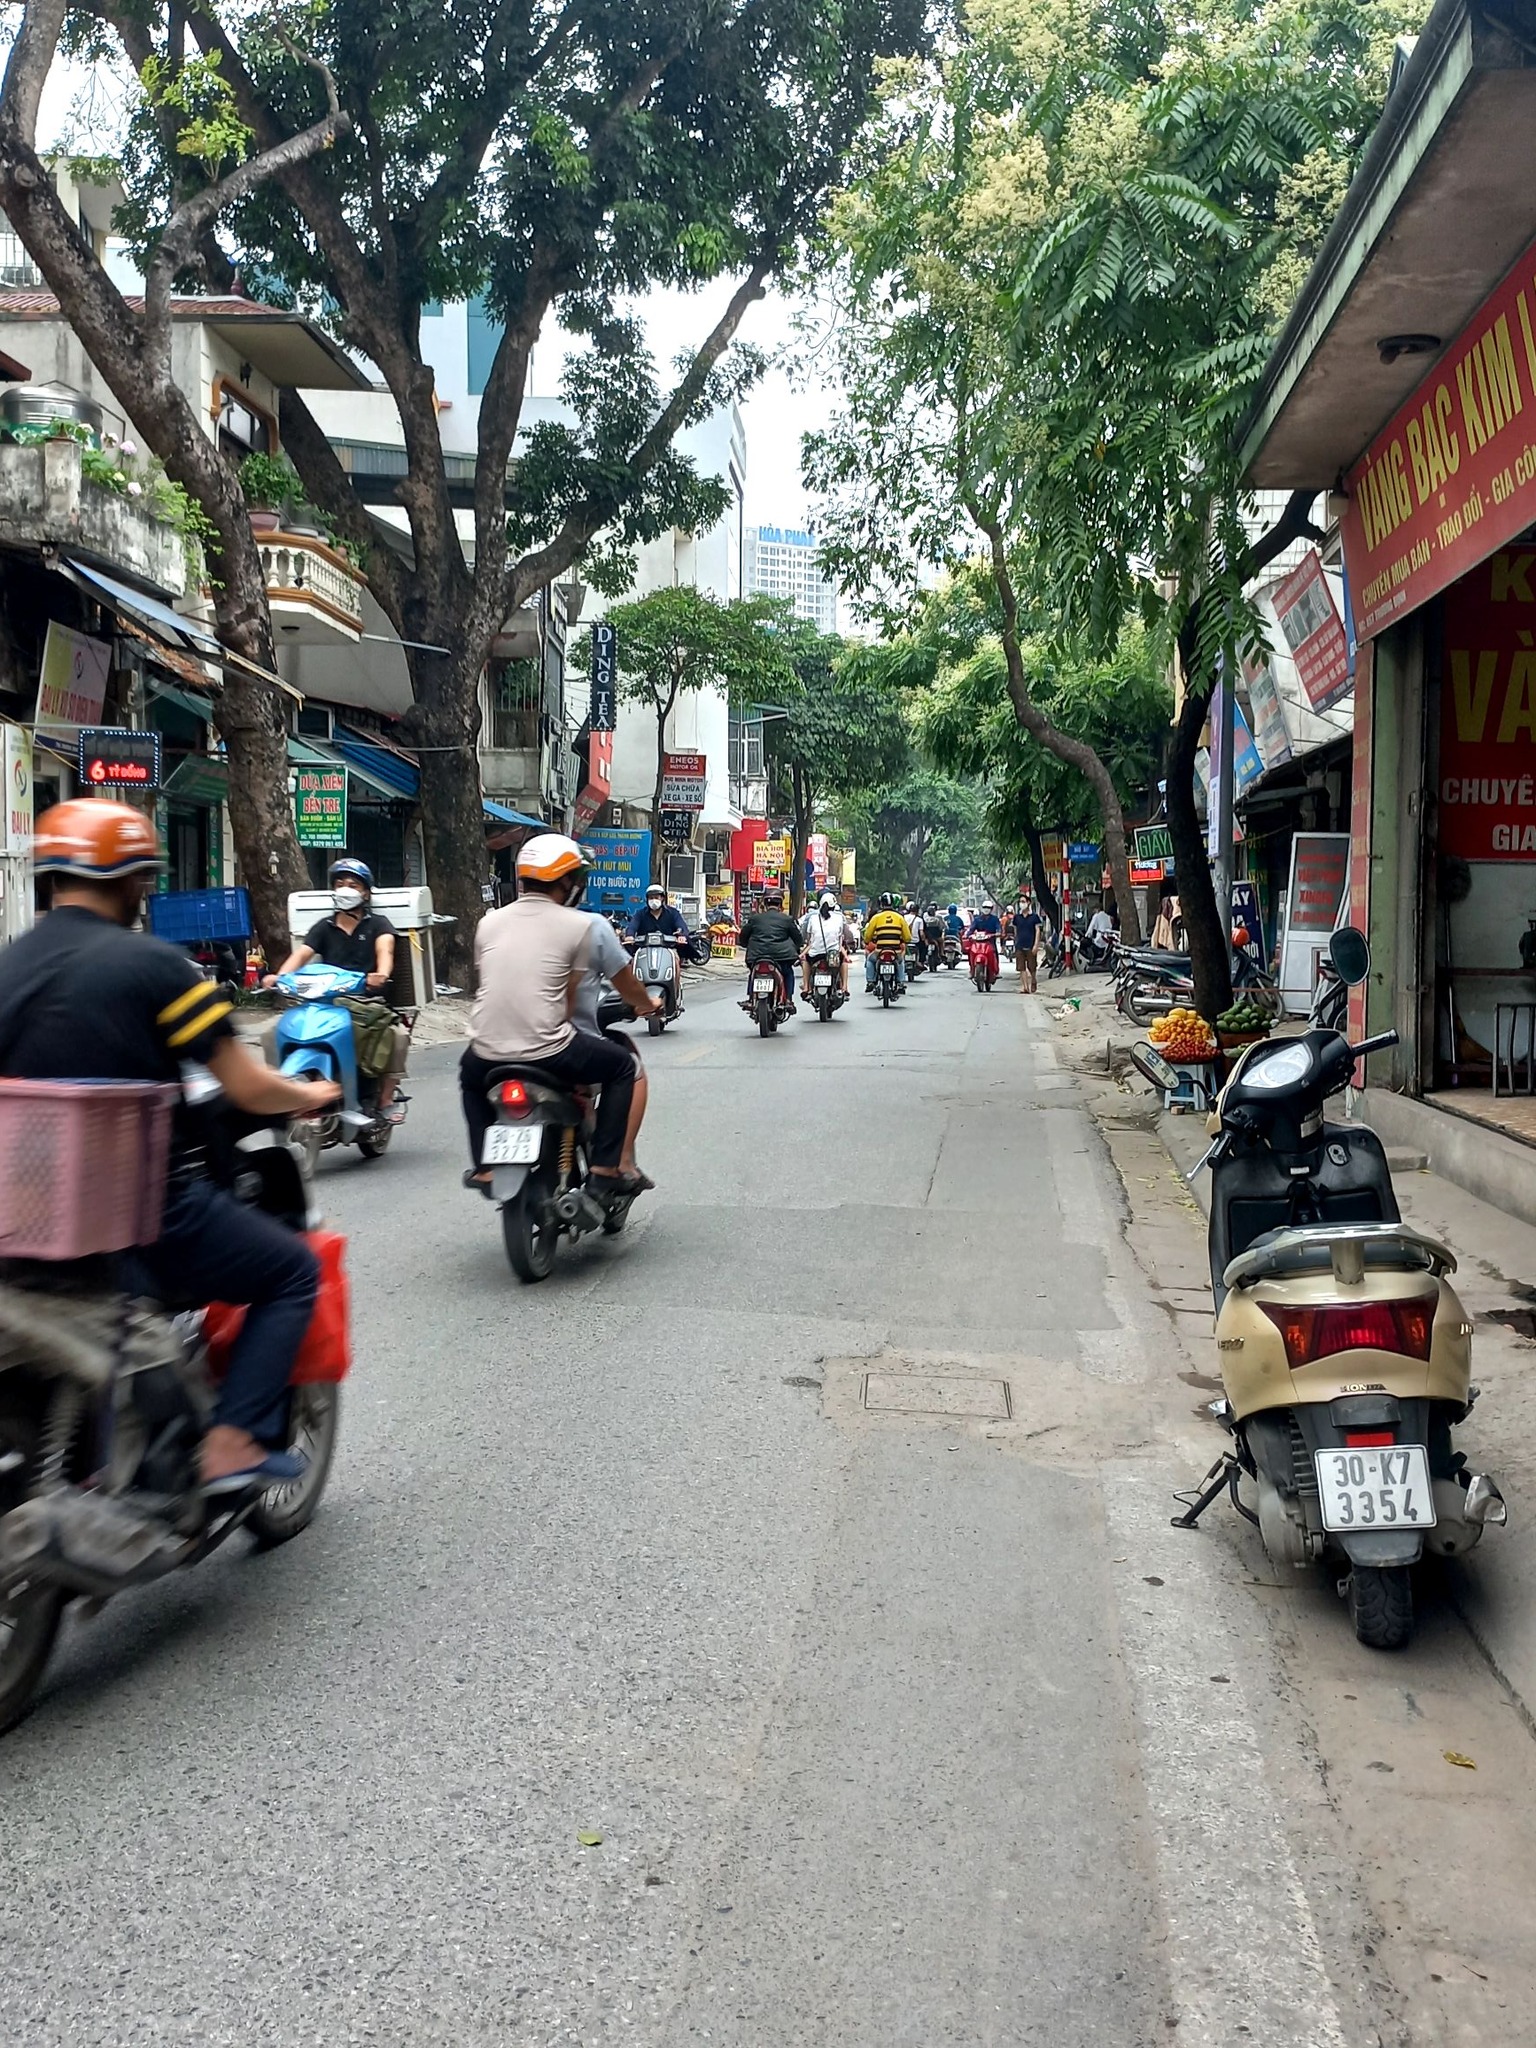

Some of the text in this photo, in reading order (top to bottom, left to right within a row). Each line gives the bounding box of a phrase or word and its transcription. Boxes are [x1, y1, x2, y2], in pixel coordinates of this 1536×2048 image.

[1357, 311, 1523, 553] VÀNG BẠC KIM
[1390, 554, 1411, 587] MUA
[1410, 537, 1431, 572] BÁN
[1436, 510, 1463, 550] TRAO
[1491, 467, 1515, 505] GIA
[597, 626, 612, 684] DING
[596, 691, 609, 728] TEA
[91, 760, 105, 780] 6
[669, 756, 699, 764] ENEOS
[322, 797, 341, 814] TRE
[664, 819, 689, 828] DING
[670, 829, 688, 837] TEA
[1340, 1383, 1387, 1392] HONDA
[1333, 1451, 1410, 1488] 30-K7
[1337, 1488, 1418, 1524] 3354
